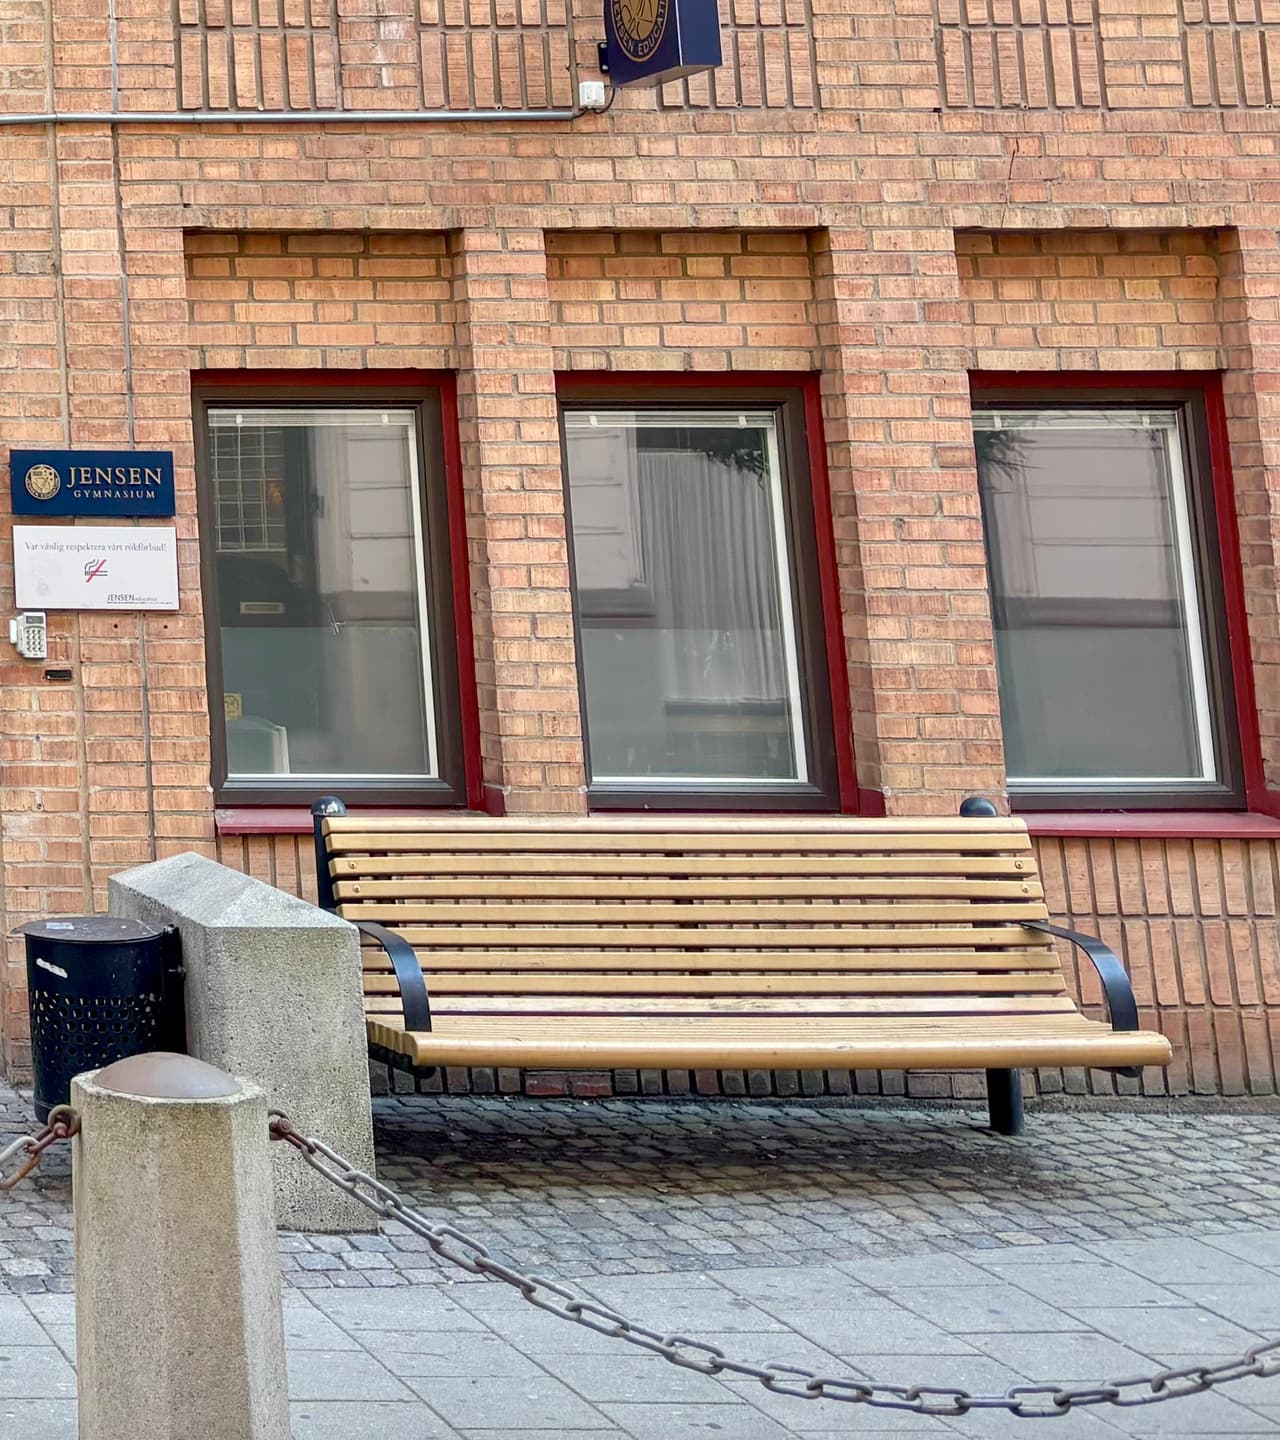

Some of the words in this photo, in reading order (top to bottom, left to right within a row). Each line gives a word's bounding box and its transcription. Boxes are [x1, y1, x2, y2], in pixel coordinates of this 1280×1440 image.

[66, 466, 162, 488] JENSEN
[73, 489, 156, 499] GYMNASIUM
[24, 541, 38, 551] Var
[39, 541, 64, 553] vänlig
[66, 541, 106, 553] respektera
